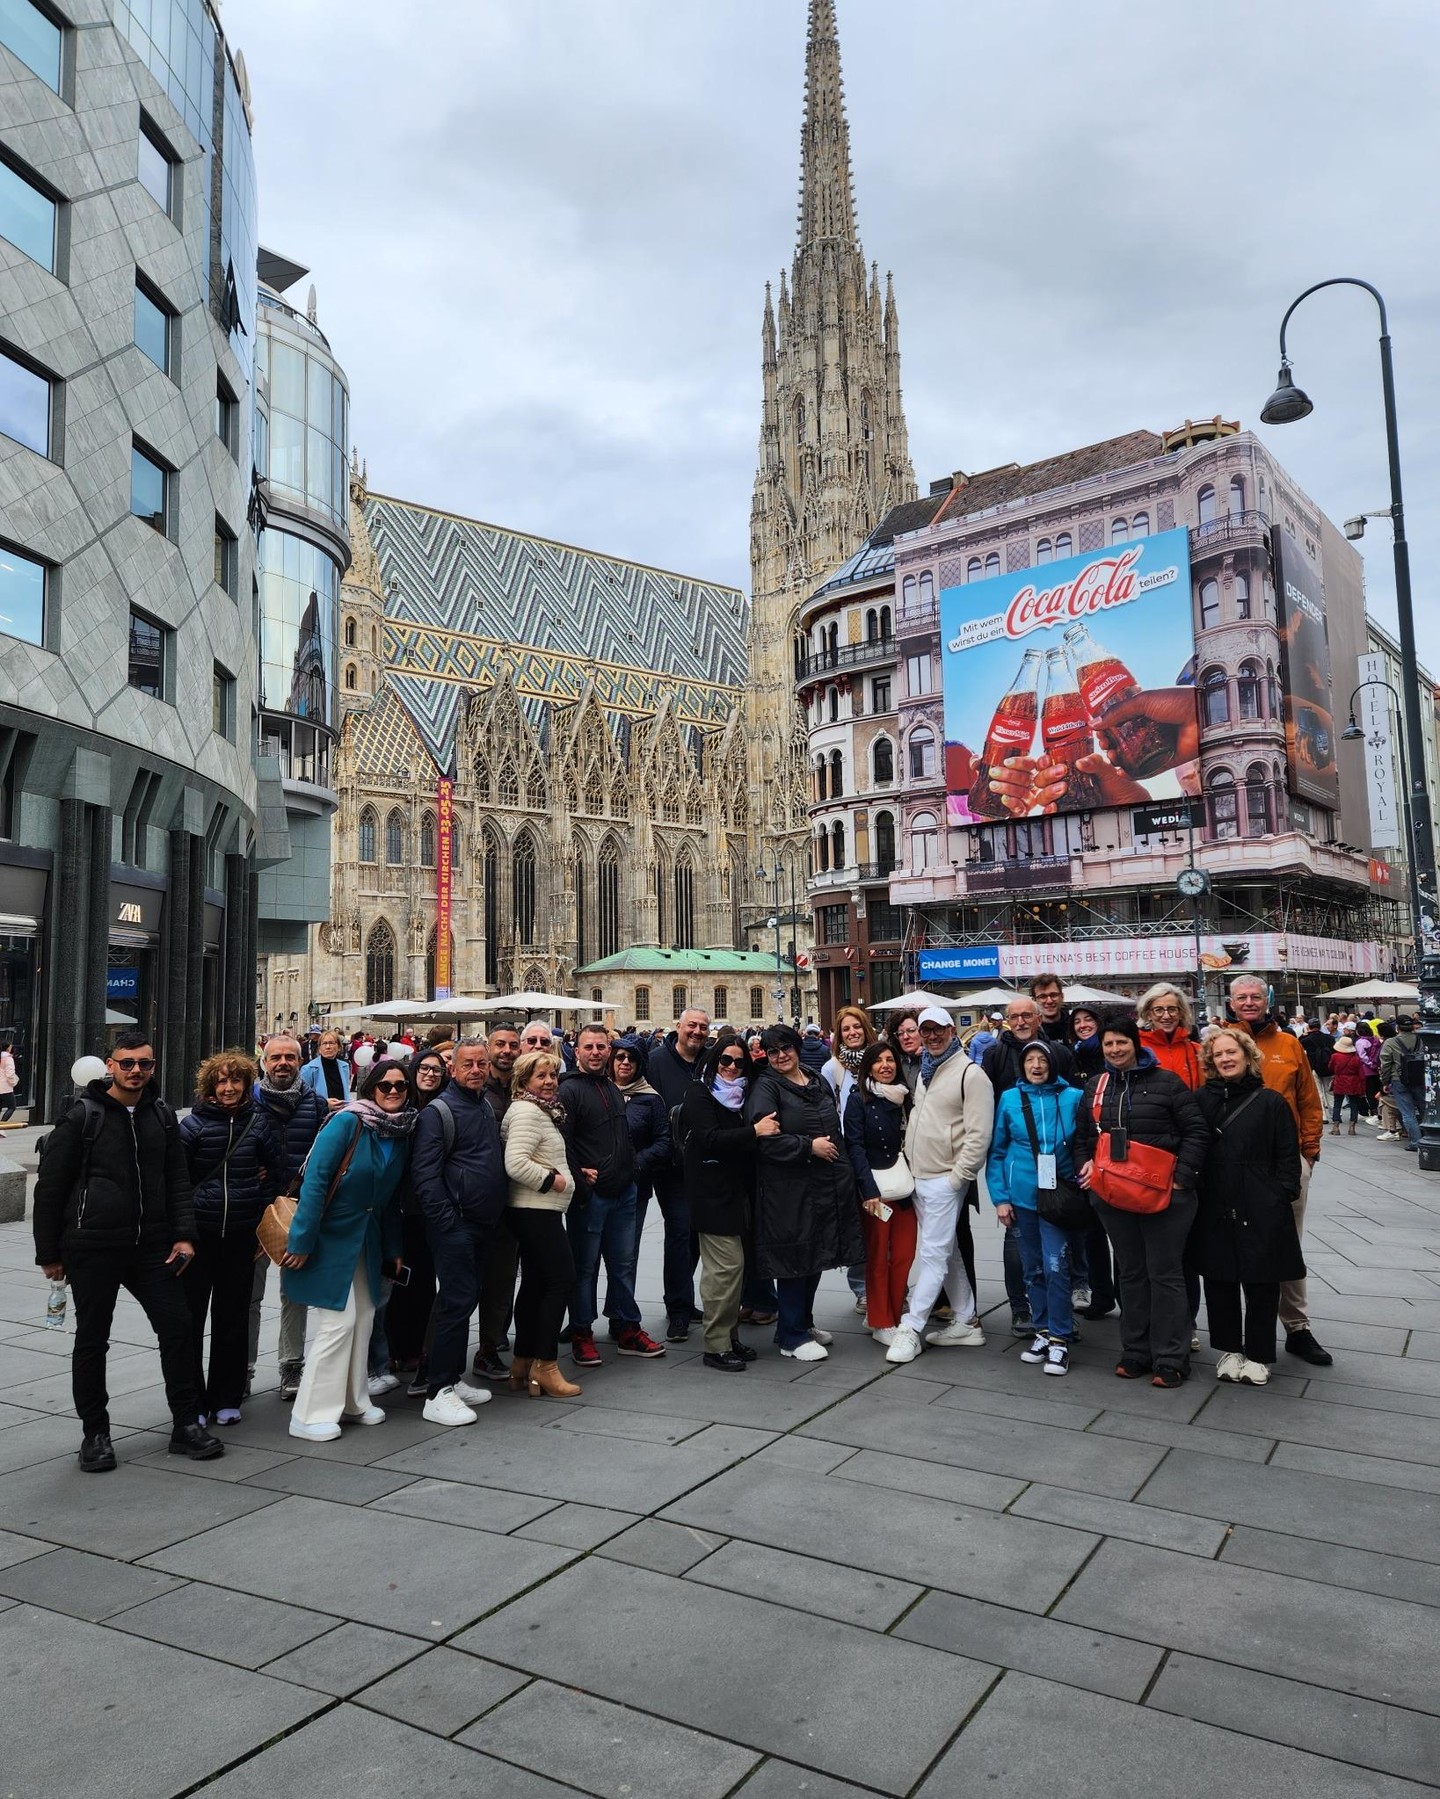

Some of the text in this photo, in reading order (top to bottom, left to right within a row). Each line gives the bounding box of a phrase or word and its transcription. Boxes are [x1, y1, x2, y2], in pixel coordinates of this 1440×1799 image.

[1139, 570, 1175, 588] teilen?
[1006, 548, 1142, 635] Coca-Cola
[1286, 581, 1323, 625] DEFENDER
[963, 616, 1003, 635] Mit wem
[952, 626, 1005, 650] wirst du ein
[1366, 661, 1388, 822] HOTEL ROYAL
[440, 780, 452, 833] 23.05.25
[1151, 811, 1180, 825] WEDI
[440, 837, 450, 886] KIRCHEN
[440, 886, 449, 908] DER
[117, 902, 142, 923] ZARA
[440, 909, 449, 947] NACHT
[921, 957, 998, 970] CHANGE MONEY
[1002, 947, 1197, 965] VOTED VIENNA'S BEST COFFEE HOUSE
